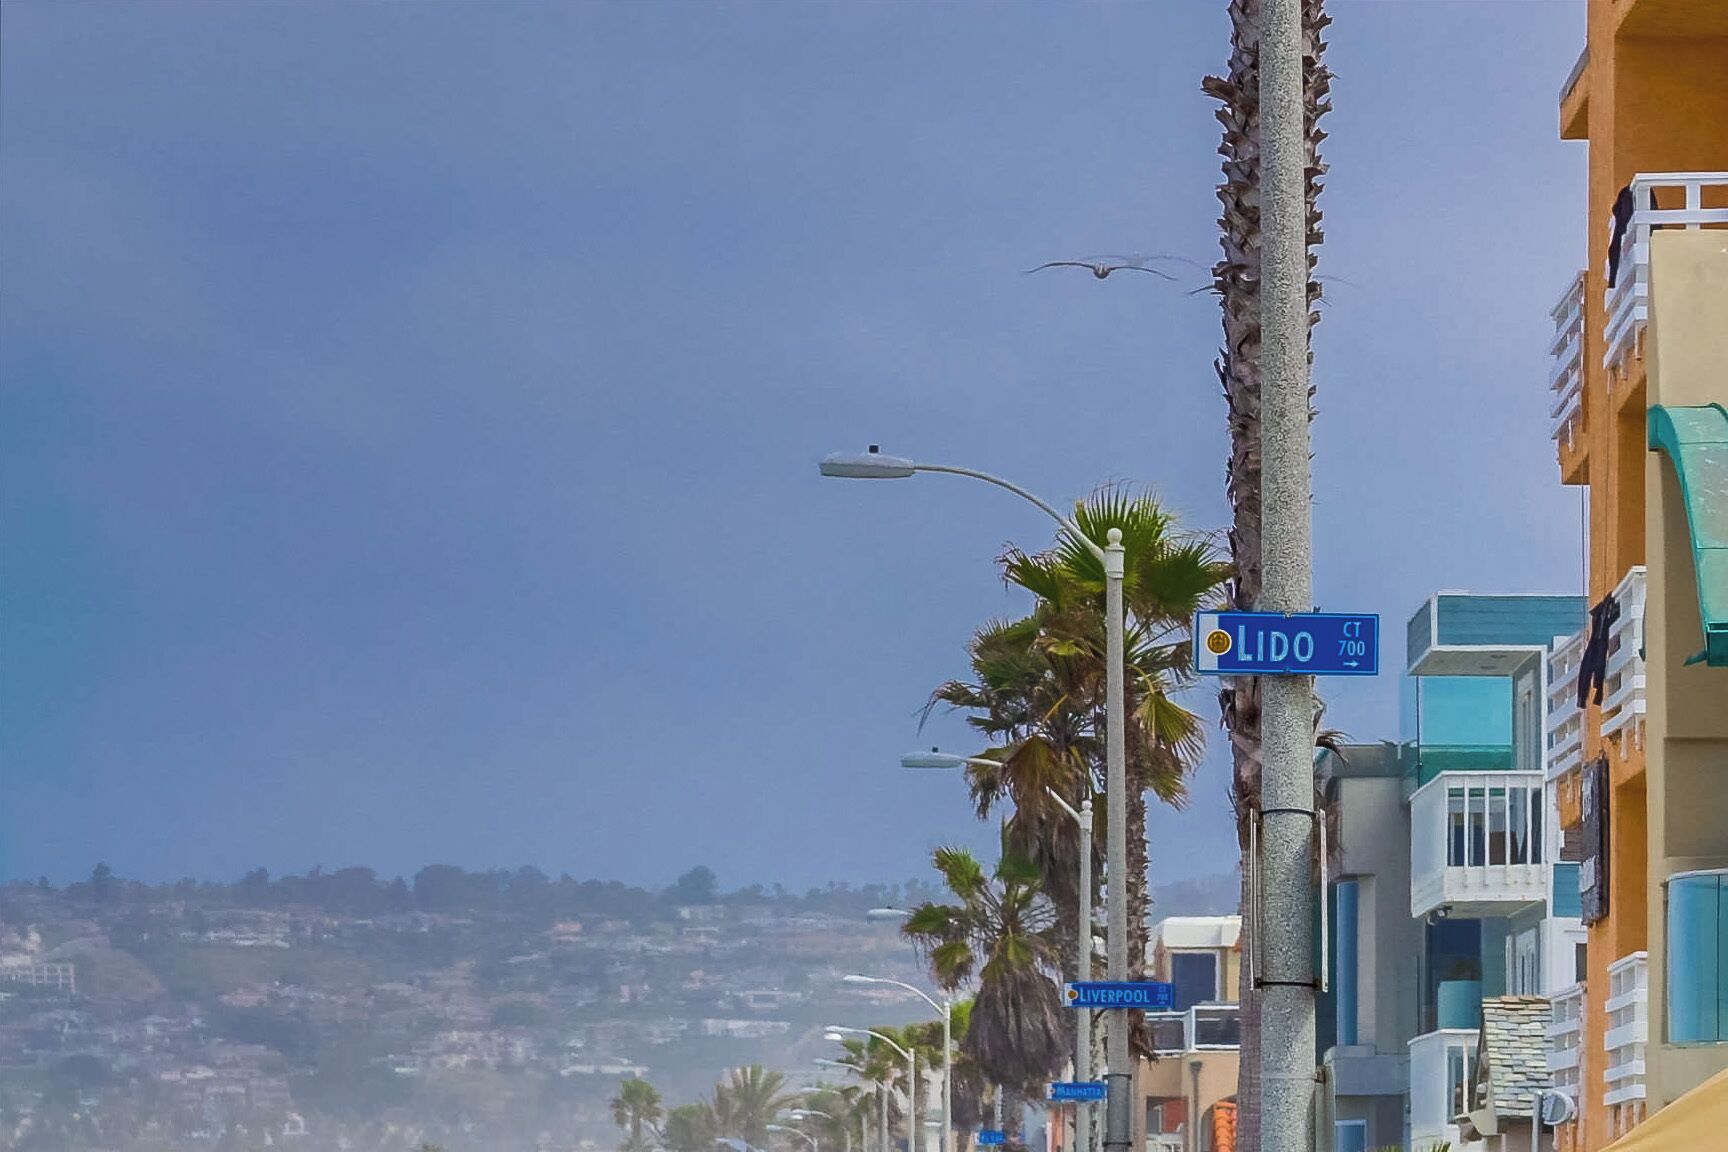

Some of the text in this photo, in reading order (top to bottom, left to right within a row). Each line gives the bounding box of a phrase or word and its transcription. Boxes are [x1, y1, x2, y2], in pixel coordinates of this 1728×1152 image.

[1342, 621, 1362, 637] CT
[1237, 624, 1314, 662] LIDO
[1337, 640, 1366, 656] 700
[1079, 986, 1150, 1003] LIVERPOOL
